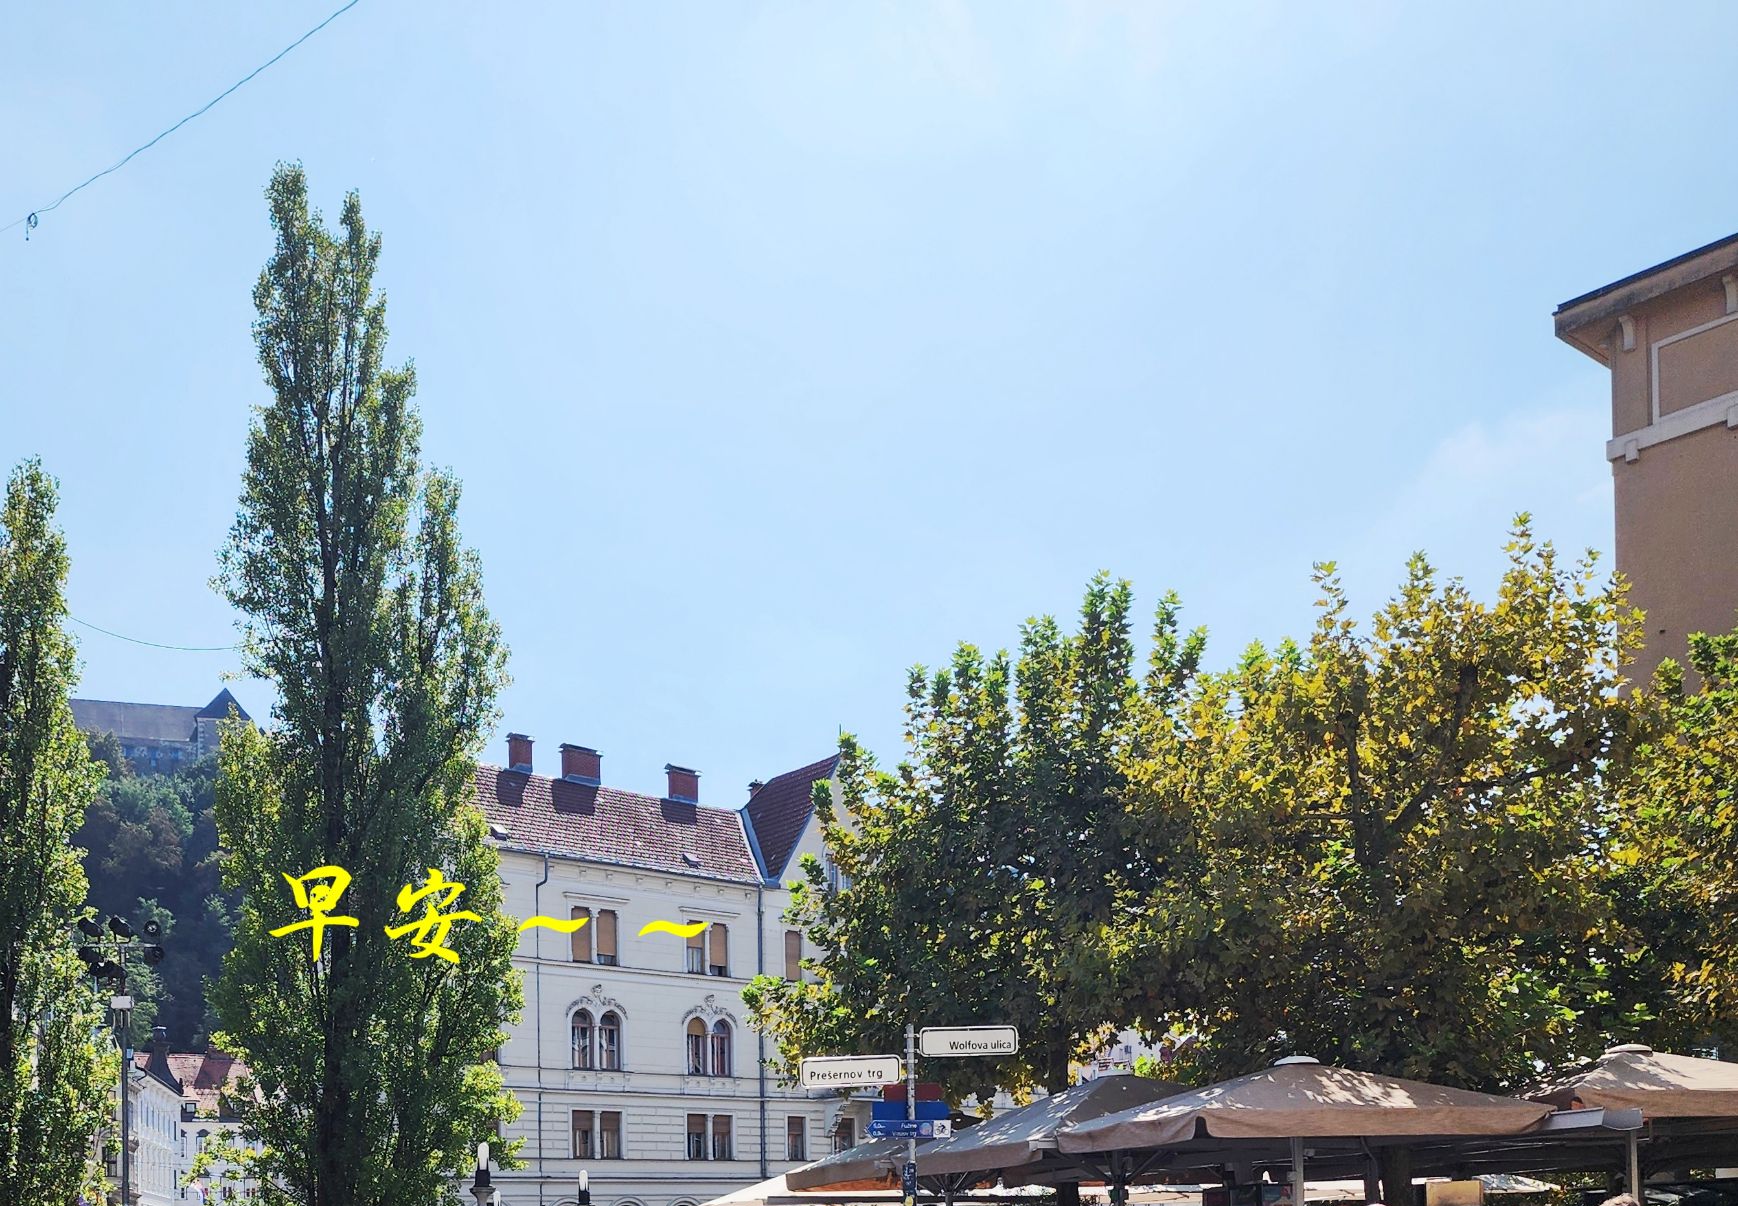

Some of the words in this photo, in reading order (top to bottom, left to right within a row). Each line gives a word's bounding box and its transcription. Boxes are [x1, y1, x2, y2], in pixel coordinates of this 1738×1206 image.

[949, 1040, 988, 1050] Wolfova
[990, 1040, 1012, 1049] ulica
[810, 1071, 863, 1080] Prešernov
[867, 1070, 883, 1079] trg
